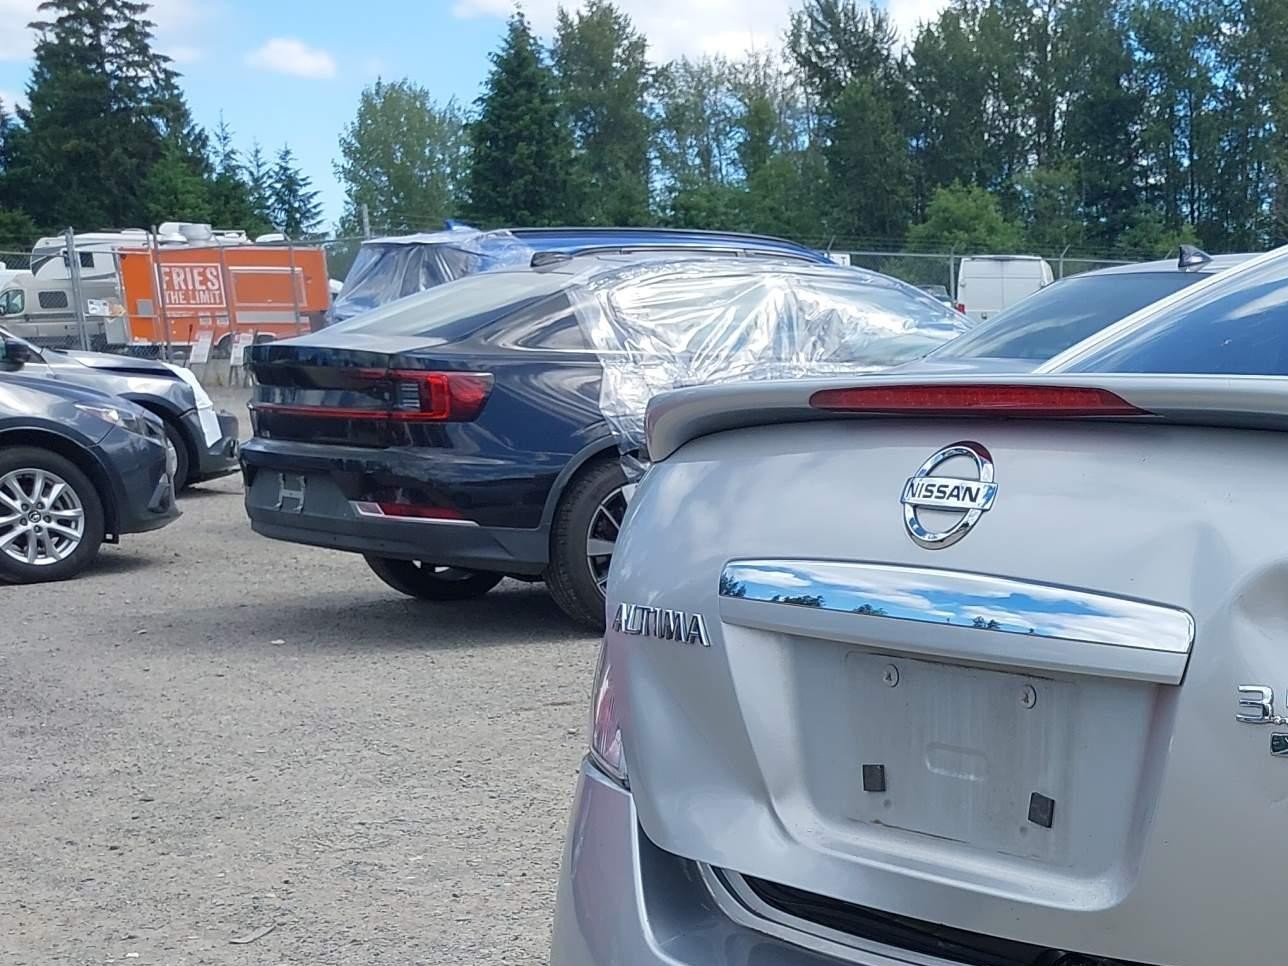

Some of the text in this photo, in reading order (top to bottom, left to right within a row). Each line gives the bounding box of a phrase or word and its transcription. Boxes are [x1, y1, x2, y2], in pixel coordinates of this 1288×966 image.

[162, 267, 219, 290] FRIES
[165, 290, 221, 304] THE LIMIT
[906, 482, 980, 503] NISSAN
[612, 602, 711, 647] ALTIMA
